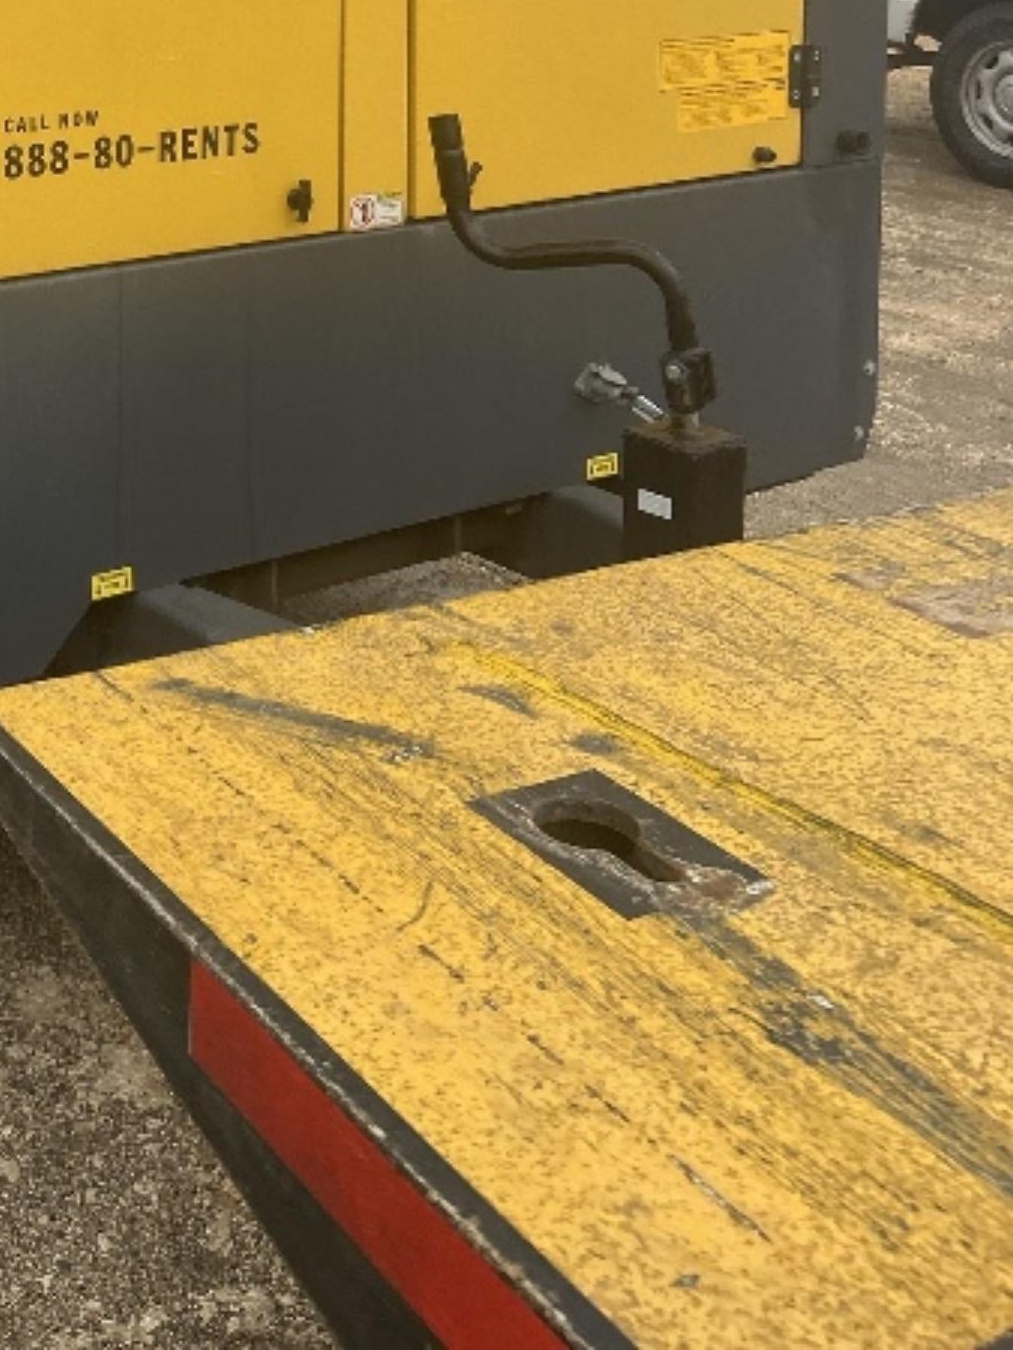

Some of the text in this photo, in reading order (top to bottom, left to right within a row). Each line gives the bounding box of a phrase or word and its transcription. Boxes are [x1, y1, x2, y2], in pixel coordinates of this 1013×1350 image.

[4, 109, 98, 133] CALL NOW
[4, 122, 261, 180] 888-80-RENTS
